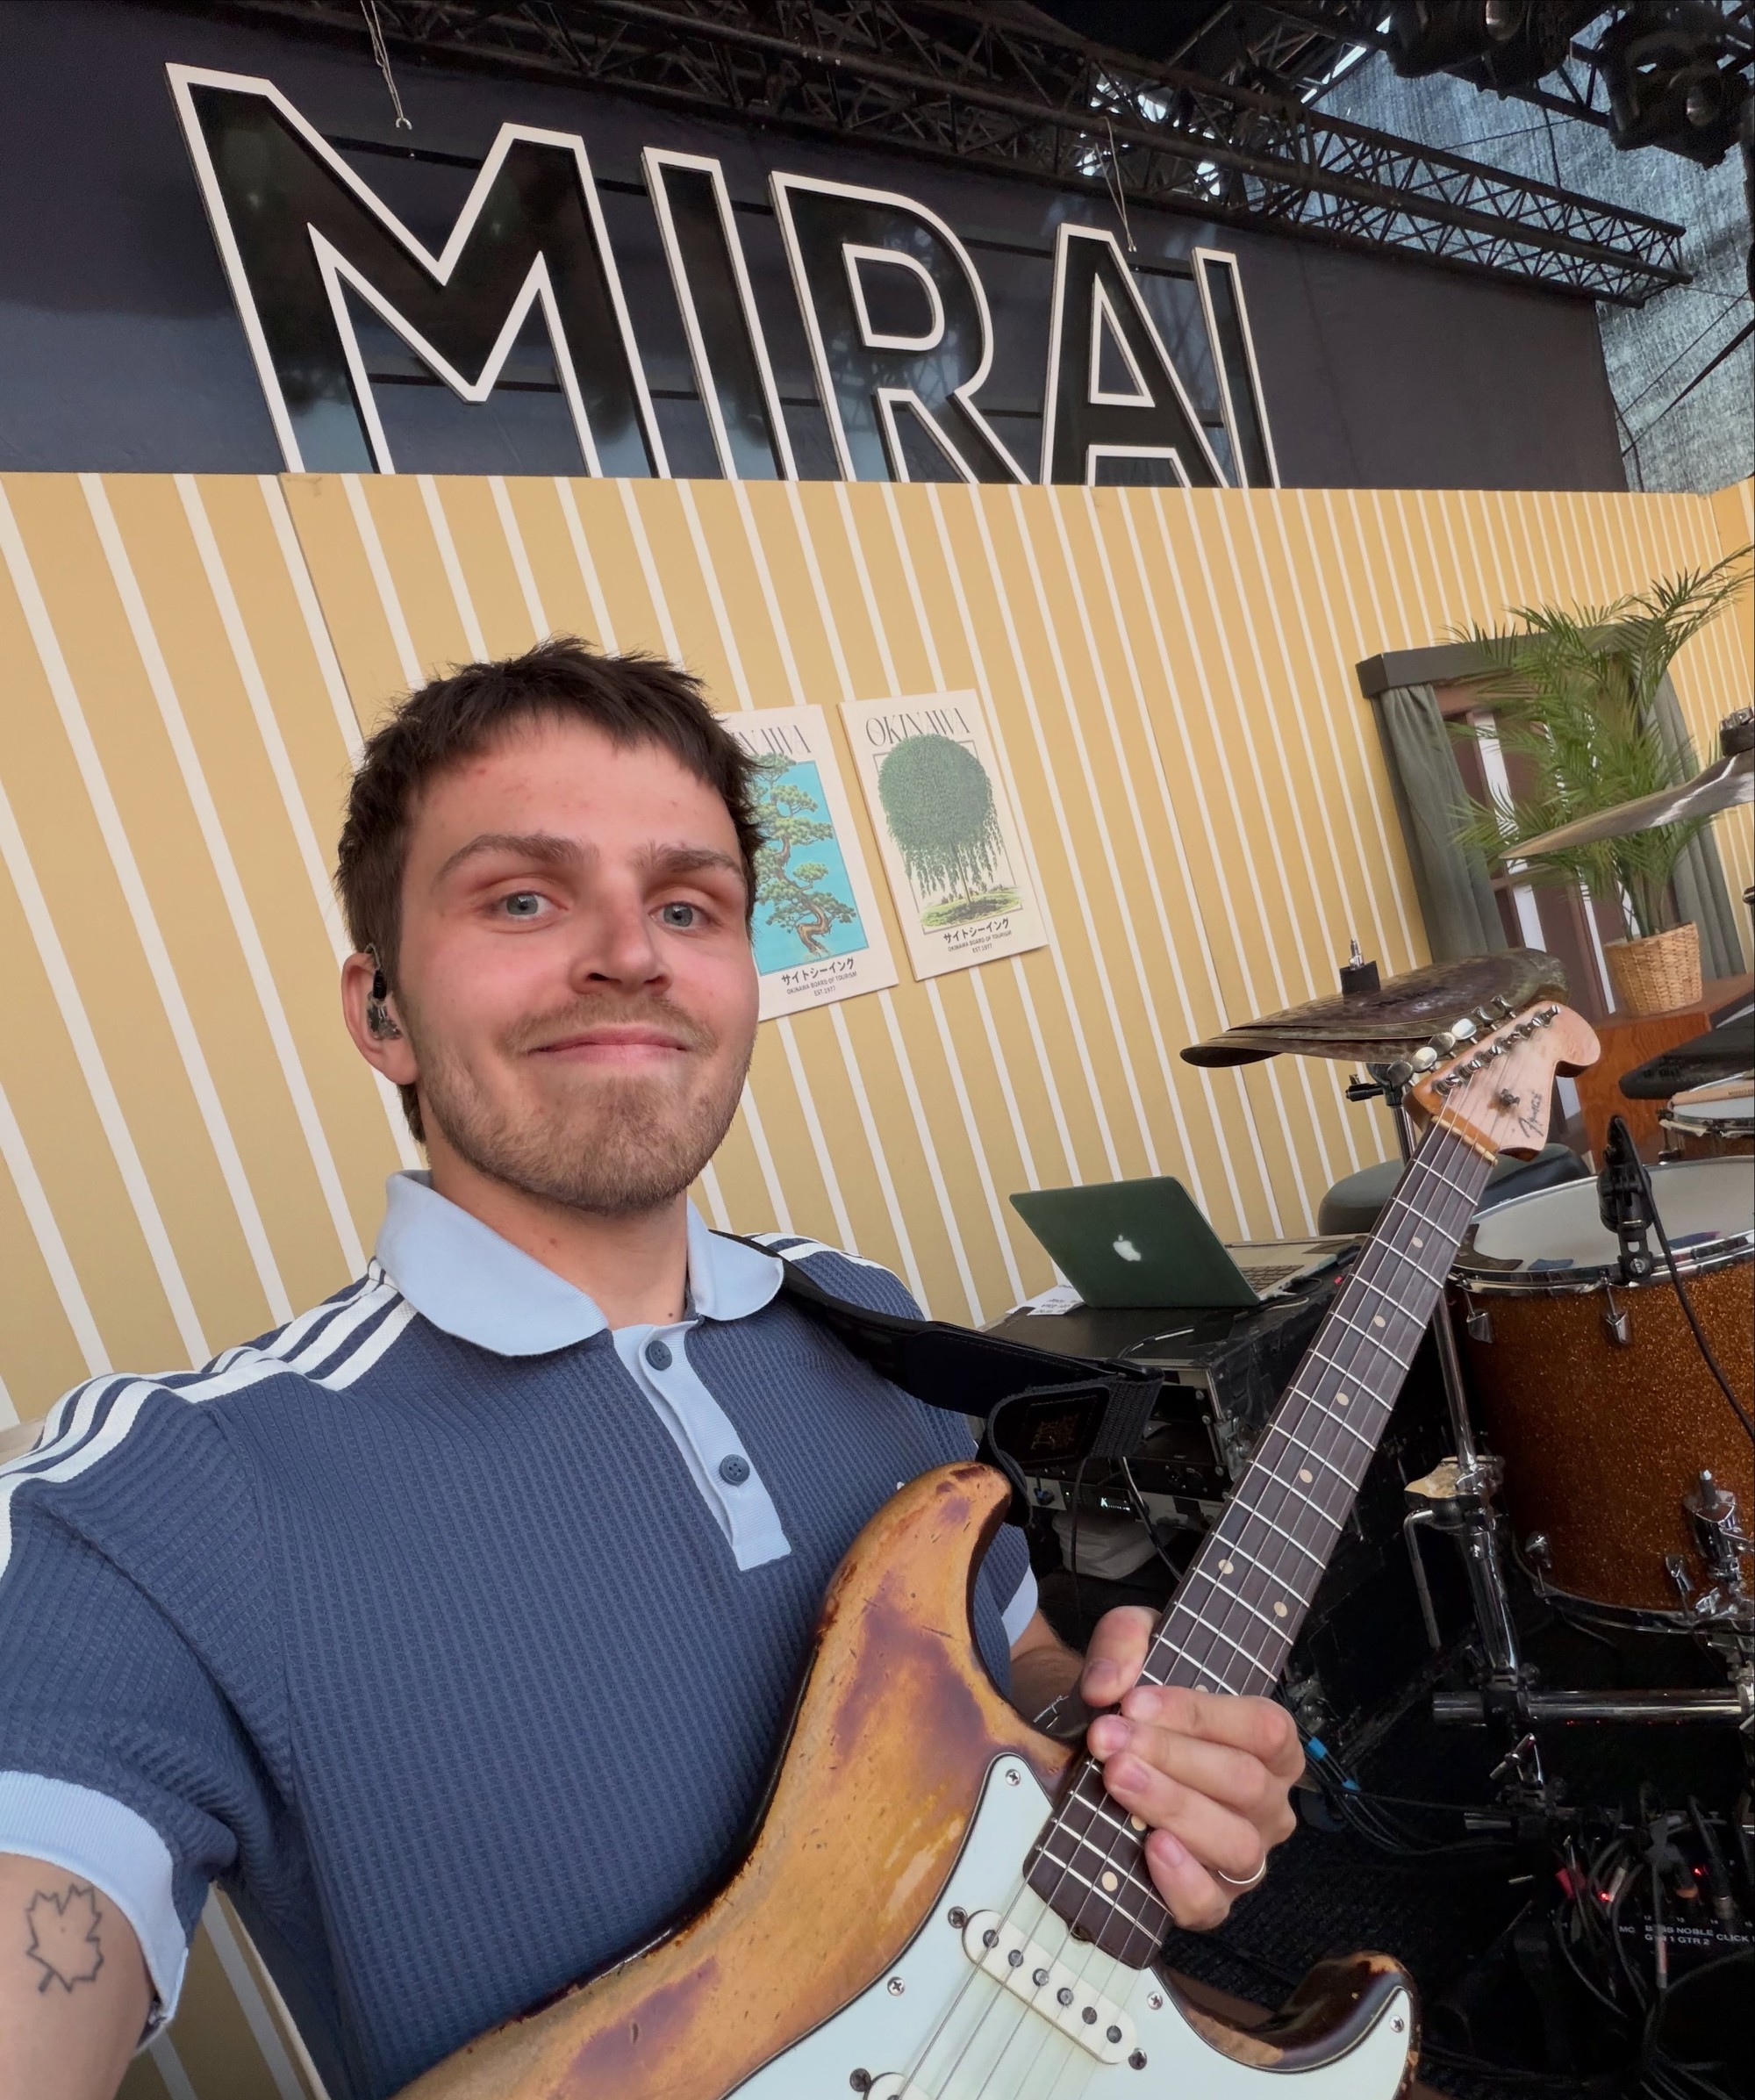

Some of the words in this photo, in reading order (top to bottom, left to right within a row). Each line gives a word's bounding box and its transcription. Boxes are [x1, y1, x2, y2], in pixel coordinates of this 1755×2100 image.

[165, 63, 1282, 488] MIRAI
[866, 708, 971, 746] OKINAWA
[738, 724, 812, 756] NAWA
[943, 917, 1009, 943] サイトシーイング
[948, 941, 969, 952] OKINAWA
[969, 937, 985, 946] BOARD
[992, 929, 1012, 940] TOURISM
[781, 957, 854, 985] サイトシーイング
[786, 984, 810, 994] OKINAWA
[810, 979, 827, 988] BOARD
[835, 971, 857, 981] TOURISM
[824, 985, 836, 994] 1977
[1644, 1924, 1674, 1934] BSS
[1676, 1927, 1714, 1936] NOBLE
[1677, 1936, 1701, 1945] GTR
